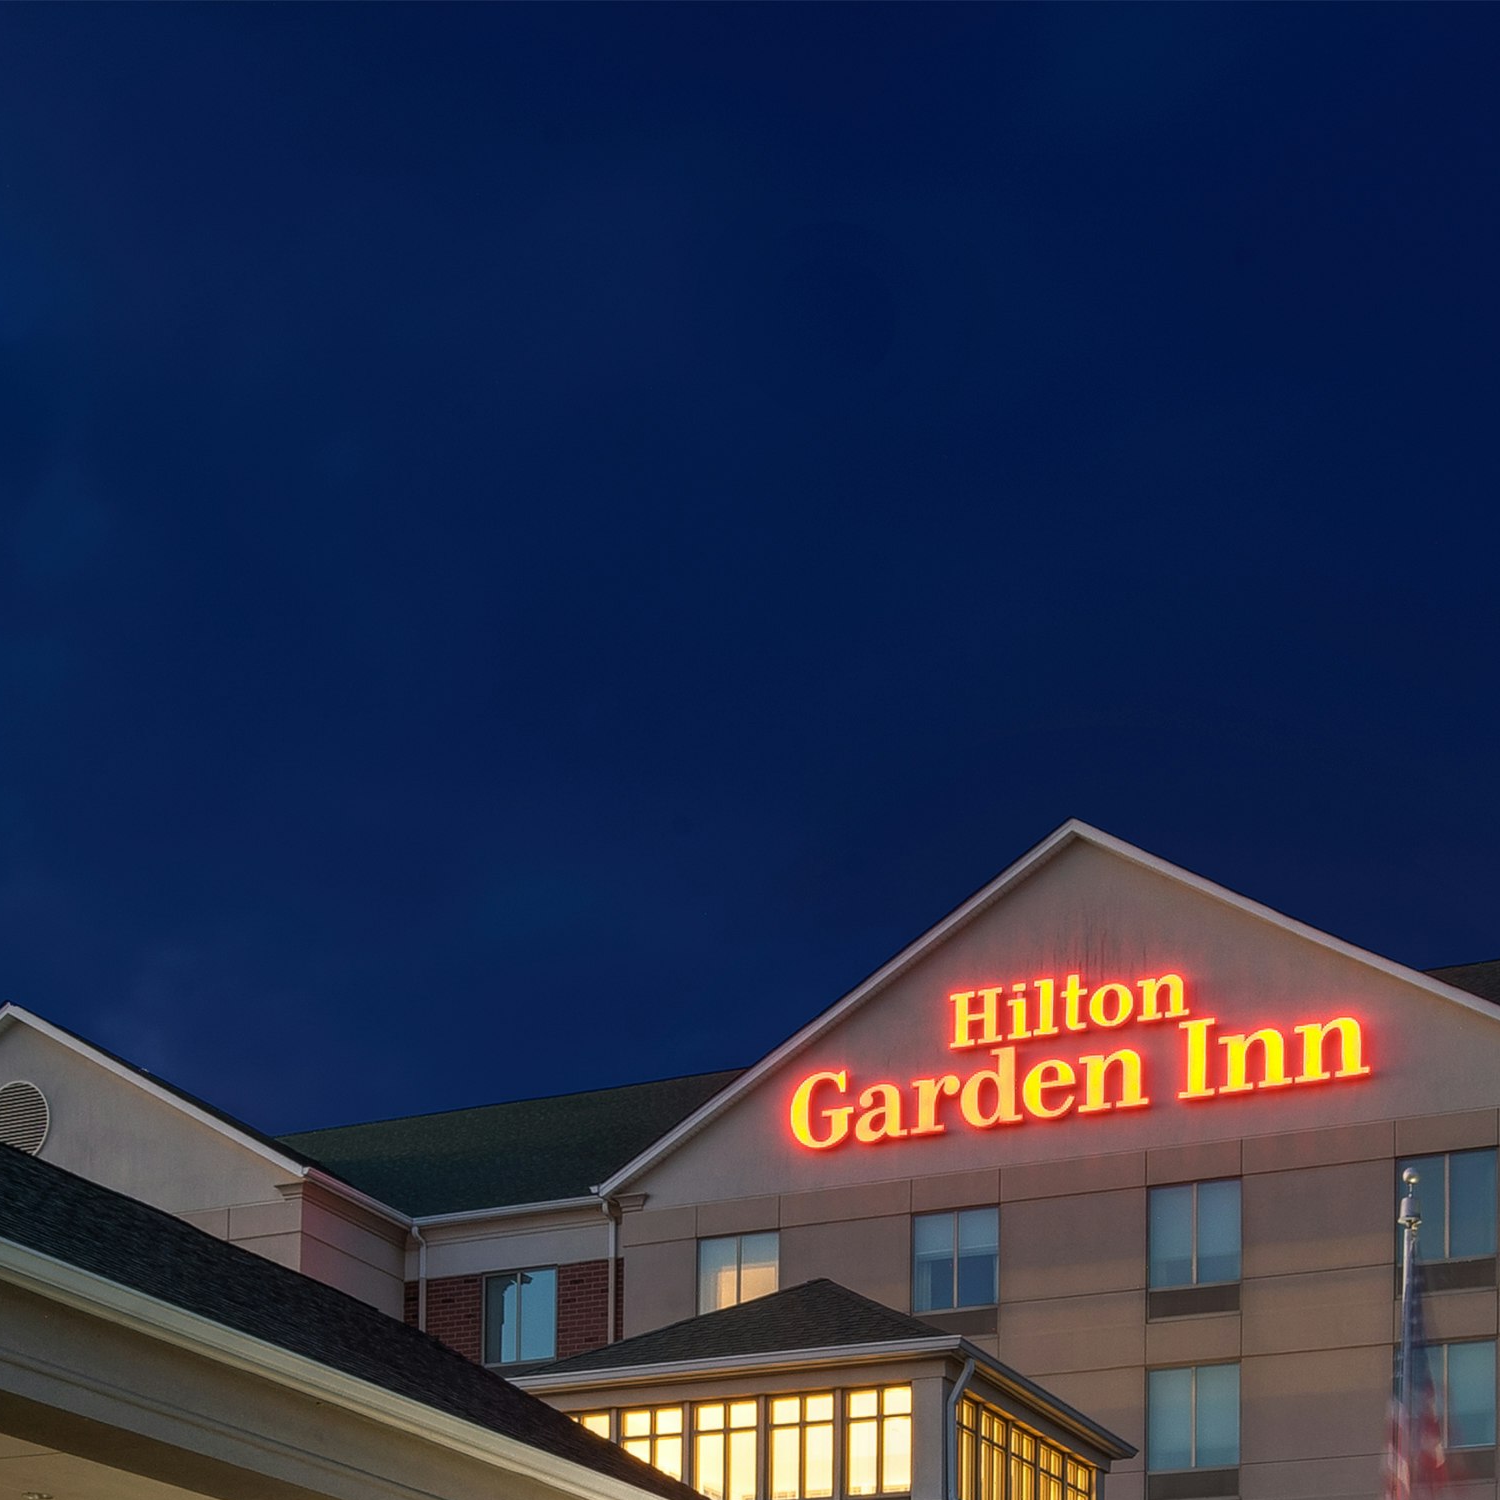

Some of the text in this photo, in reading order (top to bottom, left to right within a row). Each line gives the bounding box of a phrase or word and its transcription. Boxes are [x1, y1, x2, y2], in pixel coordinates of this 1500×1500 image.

[949, 973, 1191, 1049] Hilton
[789, 1016, 1371, 1149] Garden Inn
